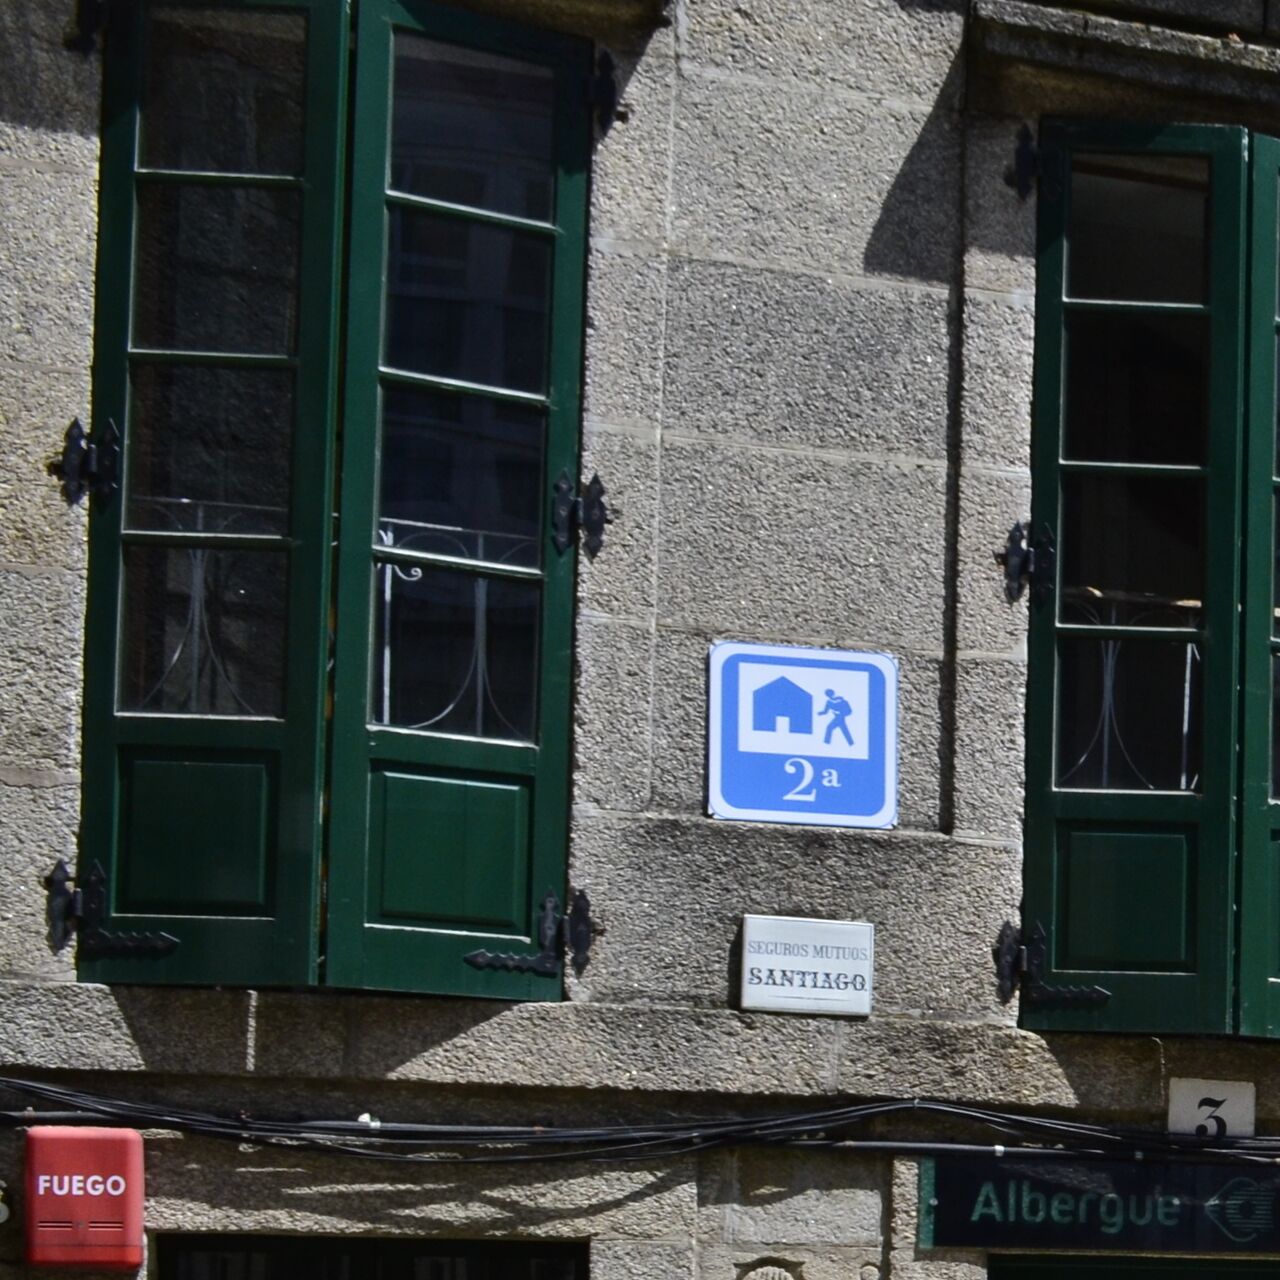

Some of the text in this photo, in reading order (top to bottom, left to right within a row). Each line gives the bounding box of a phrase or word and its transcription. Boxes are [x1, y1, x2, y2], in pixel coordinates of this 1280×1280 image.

[748, 940, 809, 958] SEGUROS
[1195, 1096, 1228, 1138] 3
[38, 1174, 126, 1196] FUEGO
[970, 1179, 1180, 1235] Albergue
